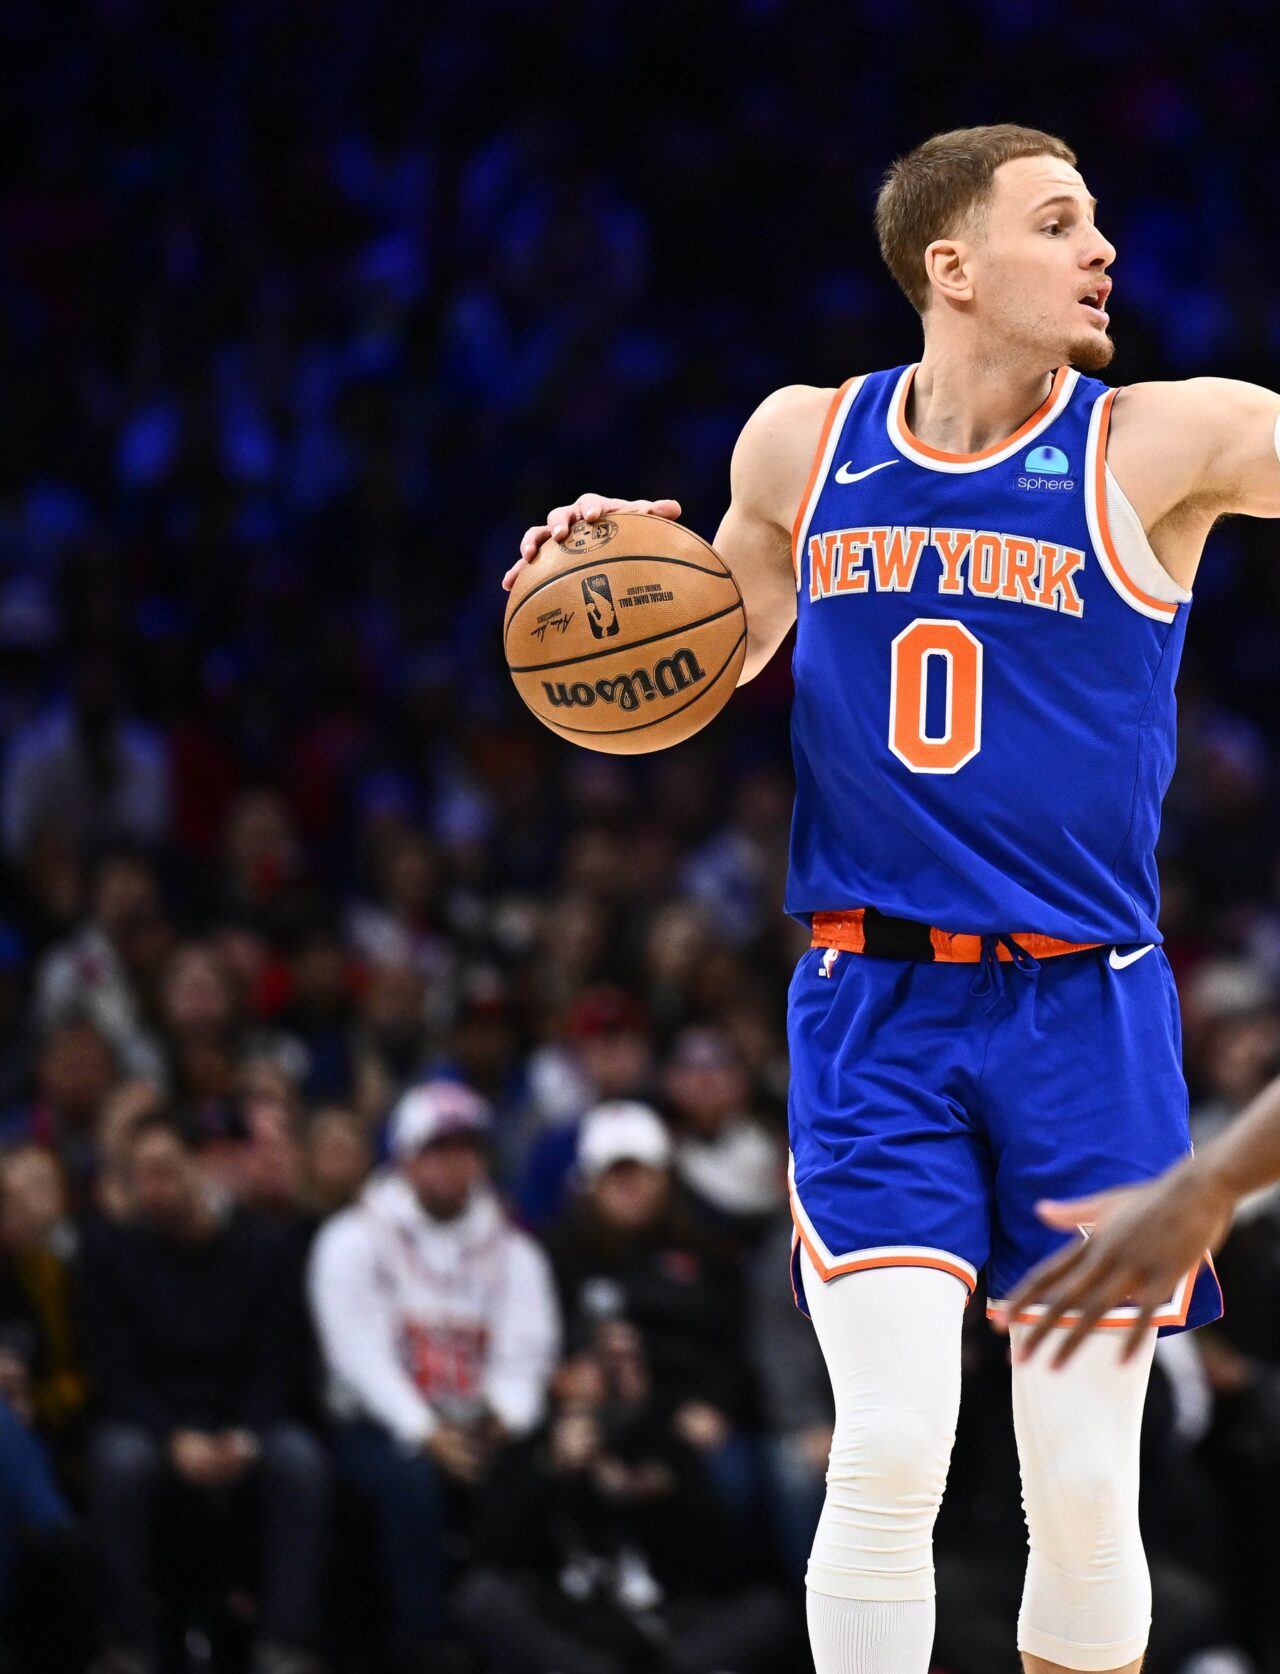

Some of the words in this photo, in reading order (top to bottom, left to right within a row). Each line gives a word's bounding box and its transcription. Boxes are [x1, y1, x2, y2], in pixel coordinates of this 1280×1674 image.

[1016, 476, 1075, 491] sphere
[808, 526, 930, 603] NEW
[930, 528, 1086, 618] YORK
[618, 597, 633, 609] BALL
[633, 594, 649, 606] GAME
[650, 591, 674, 603] OFFICIAL
[540, 647, 707, 712] Wilson
[888, 617, 983, 775] 0
